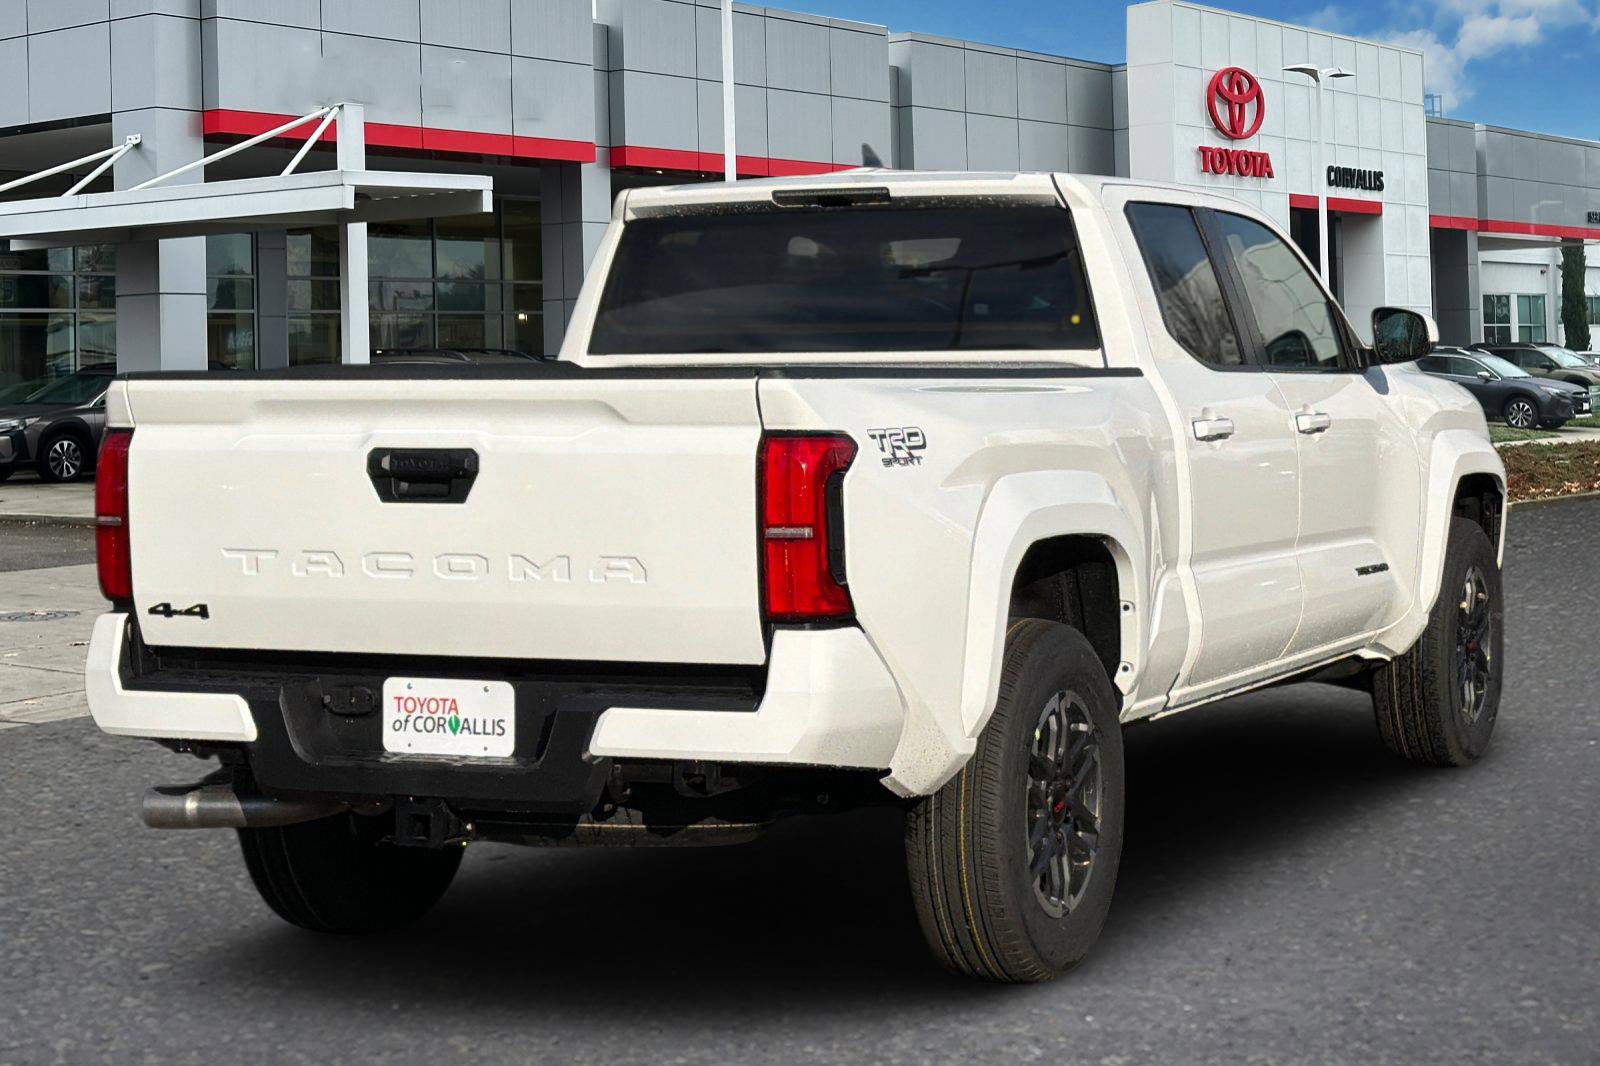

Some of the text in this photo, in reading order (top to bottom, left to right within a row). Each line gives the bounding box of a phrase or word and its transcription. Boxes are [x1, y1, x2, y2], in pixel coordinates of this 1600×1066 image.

[1198, 146, 1275, 179] TOYOTA
[1326, 165, 1385, 192] CORVALLIS
[866, 426, 927, 458] TRD
[881, 456, 923, 468] SPORT
[221, 547, 648, 584] TACOMA
[393, 696, 460, 715] TOYOTA
[392, 714, 412, 732] of
